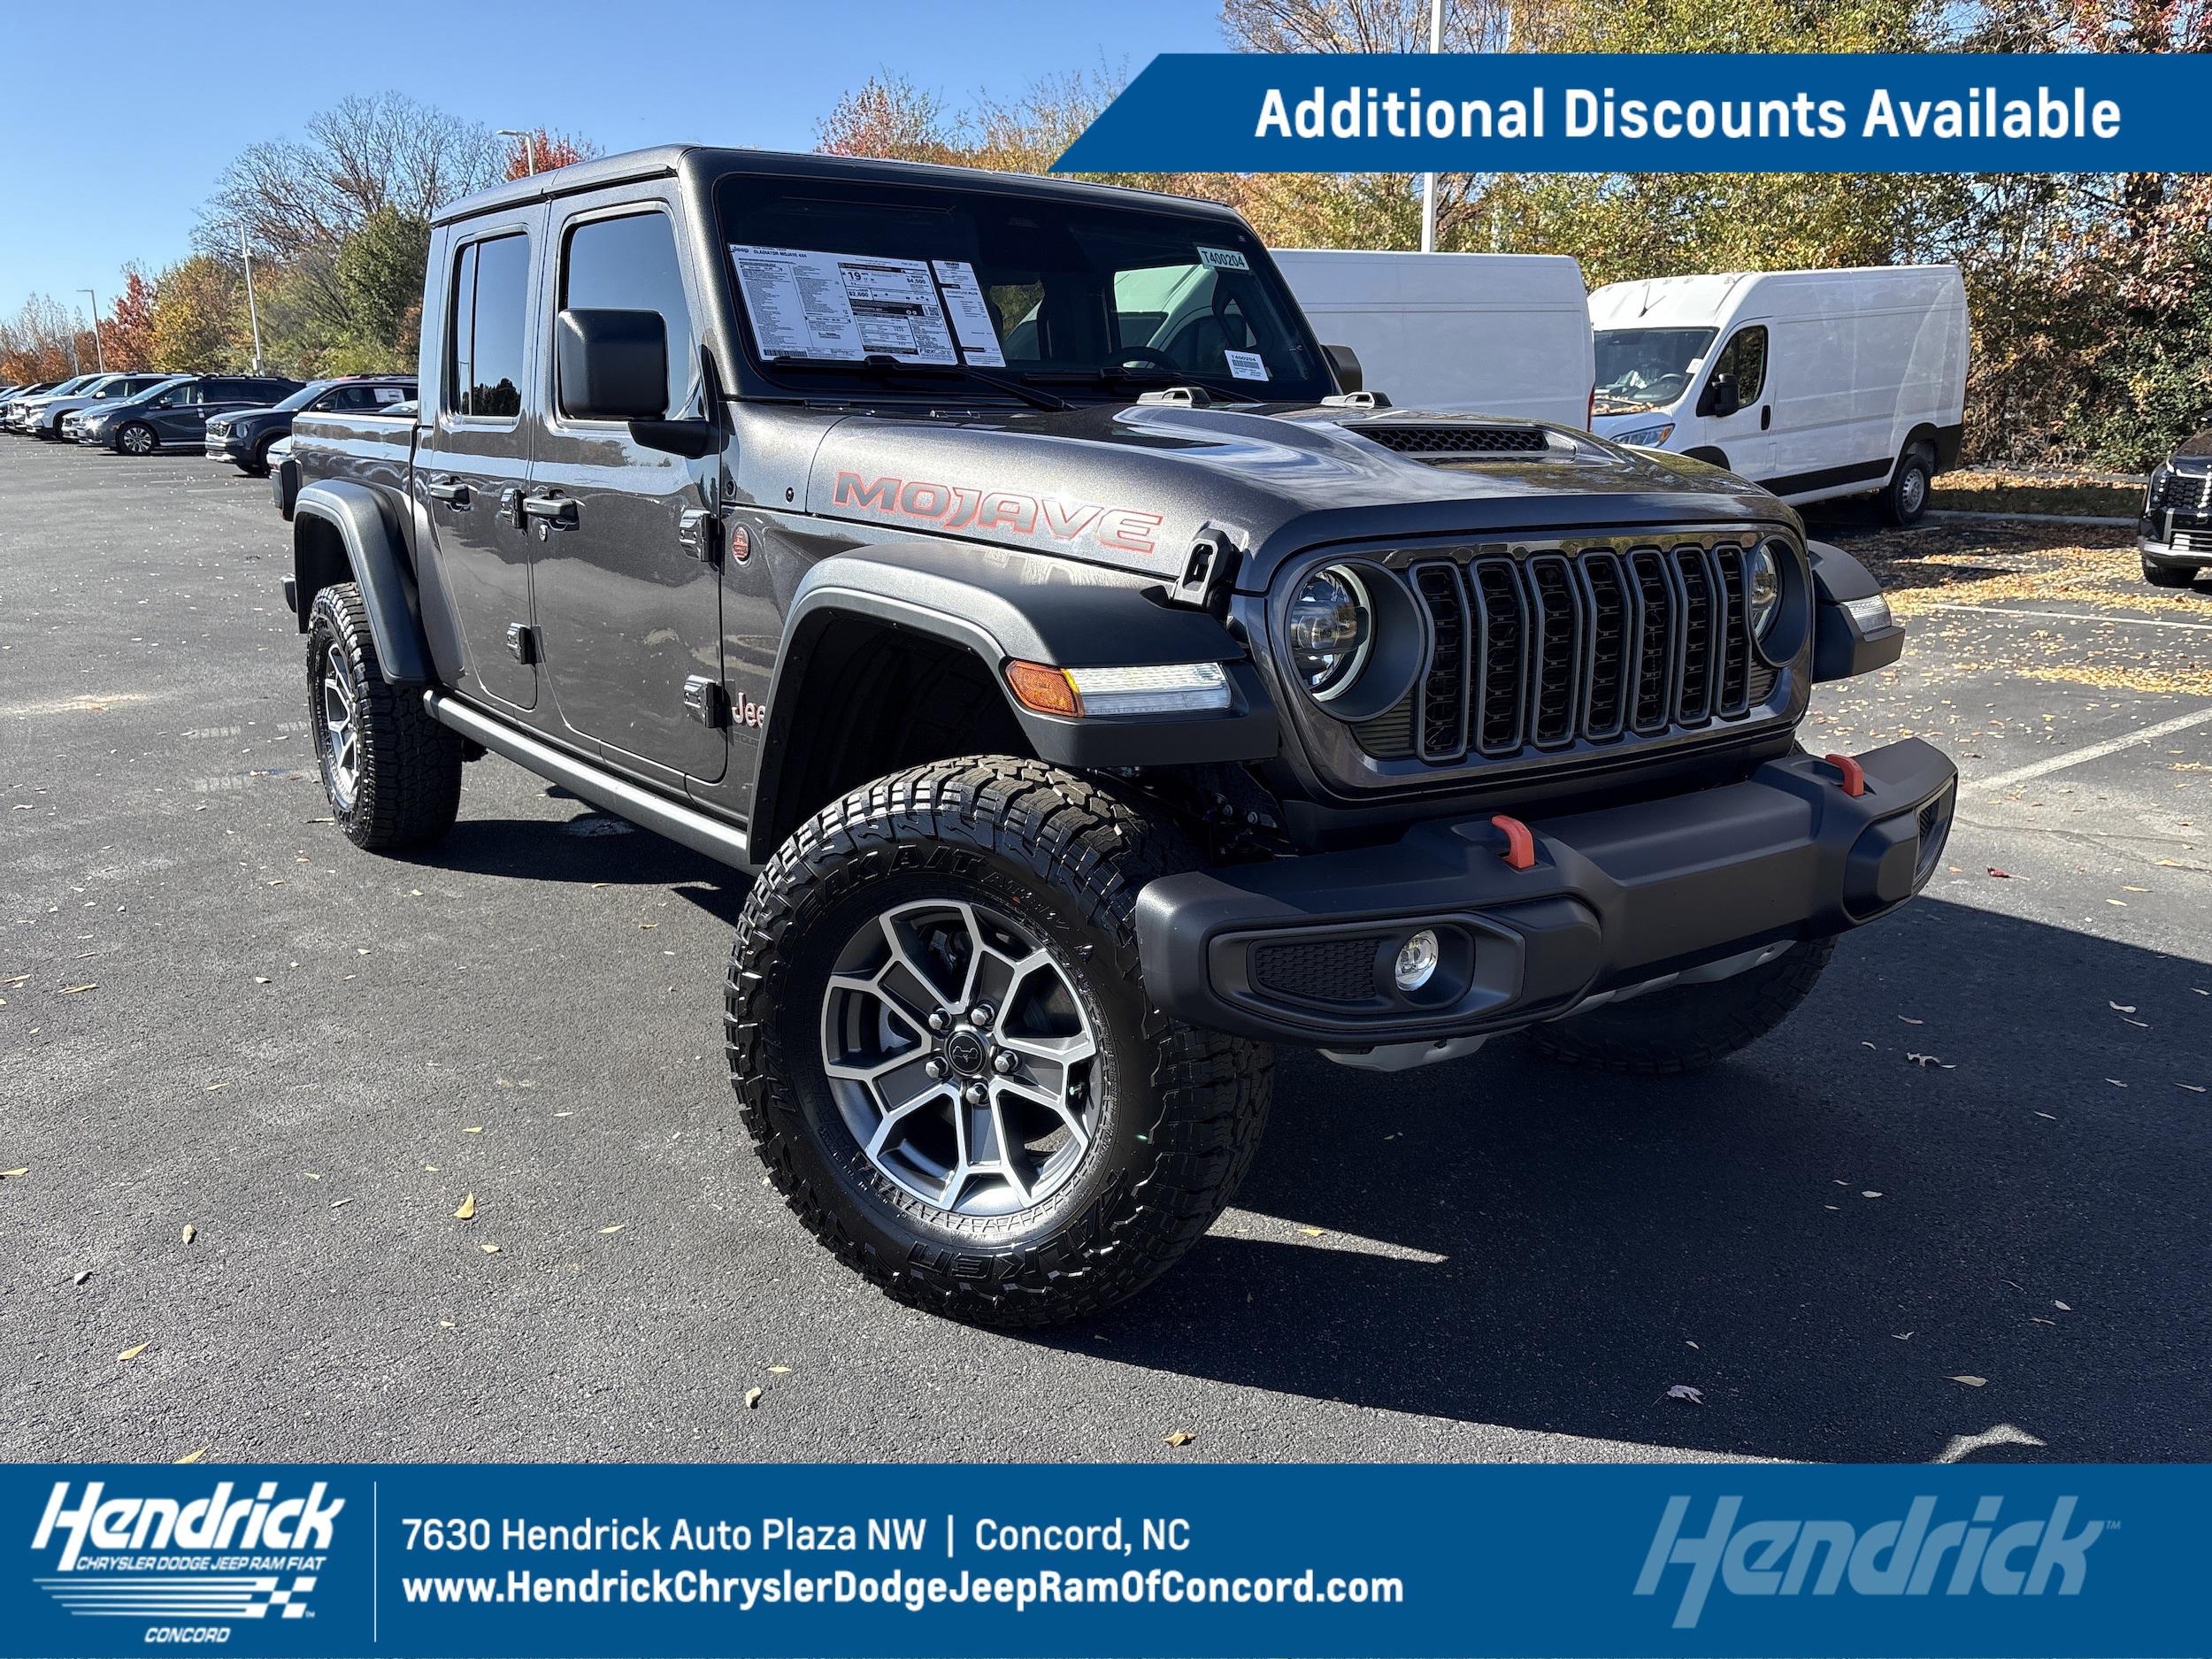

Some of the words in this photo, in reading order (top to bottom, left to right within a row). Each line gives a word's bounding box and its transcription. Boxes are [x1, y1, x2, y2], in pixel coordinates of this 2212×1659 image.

[1201, 250, 1246, 268] T400204
[848, 272, 862, 280] 19
[833, 471, 1164, 554] MOJAVE
[731, 692, 766, 729] Jee
